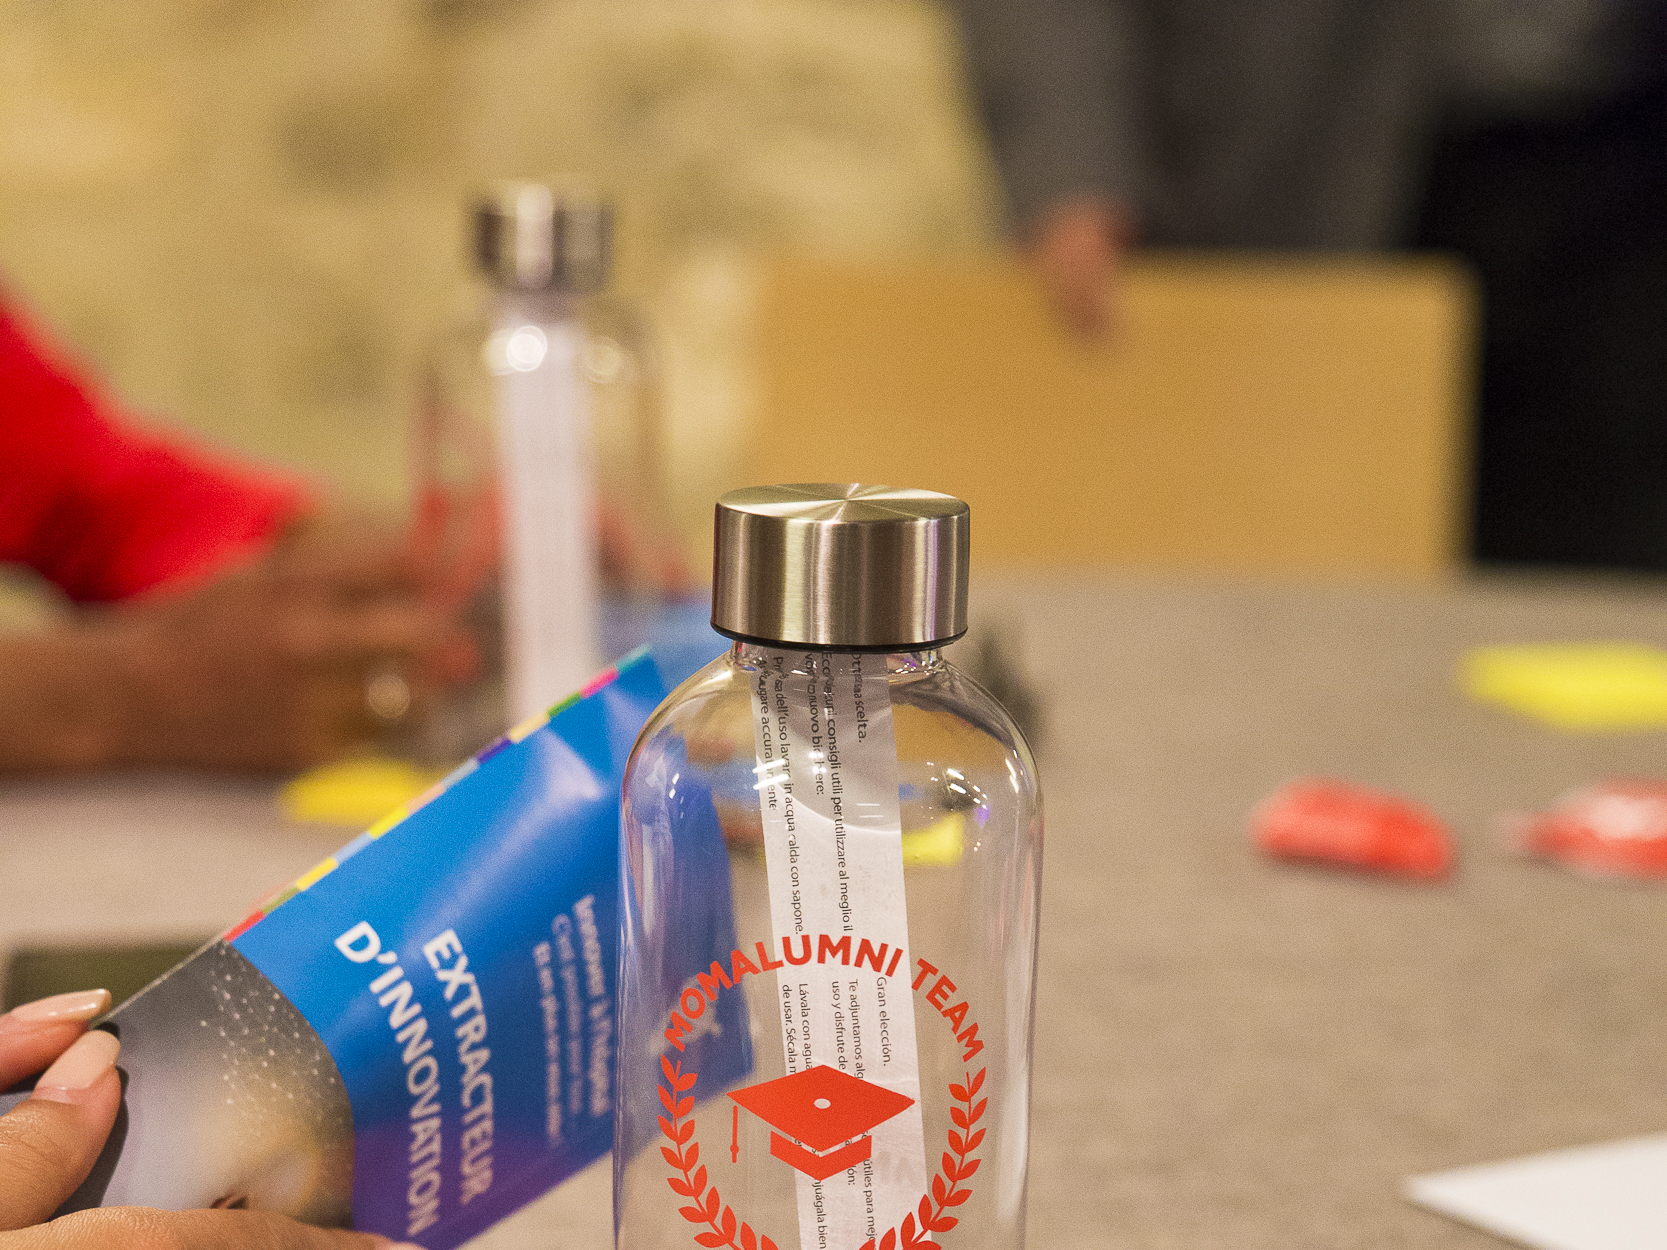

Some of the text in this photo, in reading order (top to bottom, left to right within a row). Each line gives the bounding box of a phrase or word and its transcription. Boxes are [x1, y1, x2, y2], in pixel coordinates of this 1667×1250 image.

[807, 695, 820, 733] nuovo
[854, 701, 869, 743] scelta.
[827, 719, 841, 769] consigli
[784, 783, 794, 794] in
[831, 772, 843, 794] utili
[783, 797, 795, 832] acqua
[831, 797, 842, 816] per
[834, 818, 846, 868] utilizzare
[790, 866, 800, 887] con
[839, 870, 849, 880] al
[791, 890, 804, 935] sapone.
[839, 883, 852, 923] meglio
[664, 934, 904, 1053] MOMALUMNI
[911, 958, 985, 1063] TEAM
[782, 984, 792, 998] de
[799, 983, 811, 1018] Lávala
[848, 979, 858, 991] Te
[783, 1001, 794, 1026] usar.
[802, 1019, 811, 1041] con
[831, 981, 848, 1070] uso y disfrute de
[848, 994, 863, 1060] adjuntamos
[876, 977, 892, 1067] Gran elección.
[786, 1028, 798, 1063] Sécala
[423, 928, 495, 1205] EXTRACTEUR
[863, 1190, 875, 1214] para
[817, 1225, 828, 1249] bien
